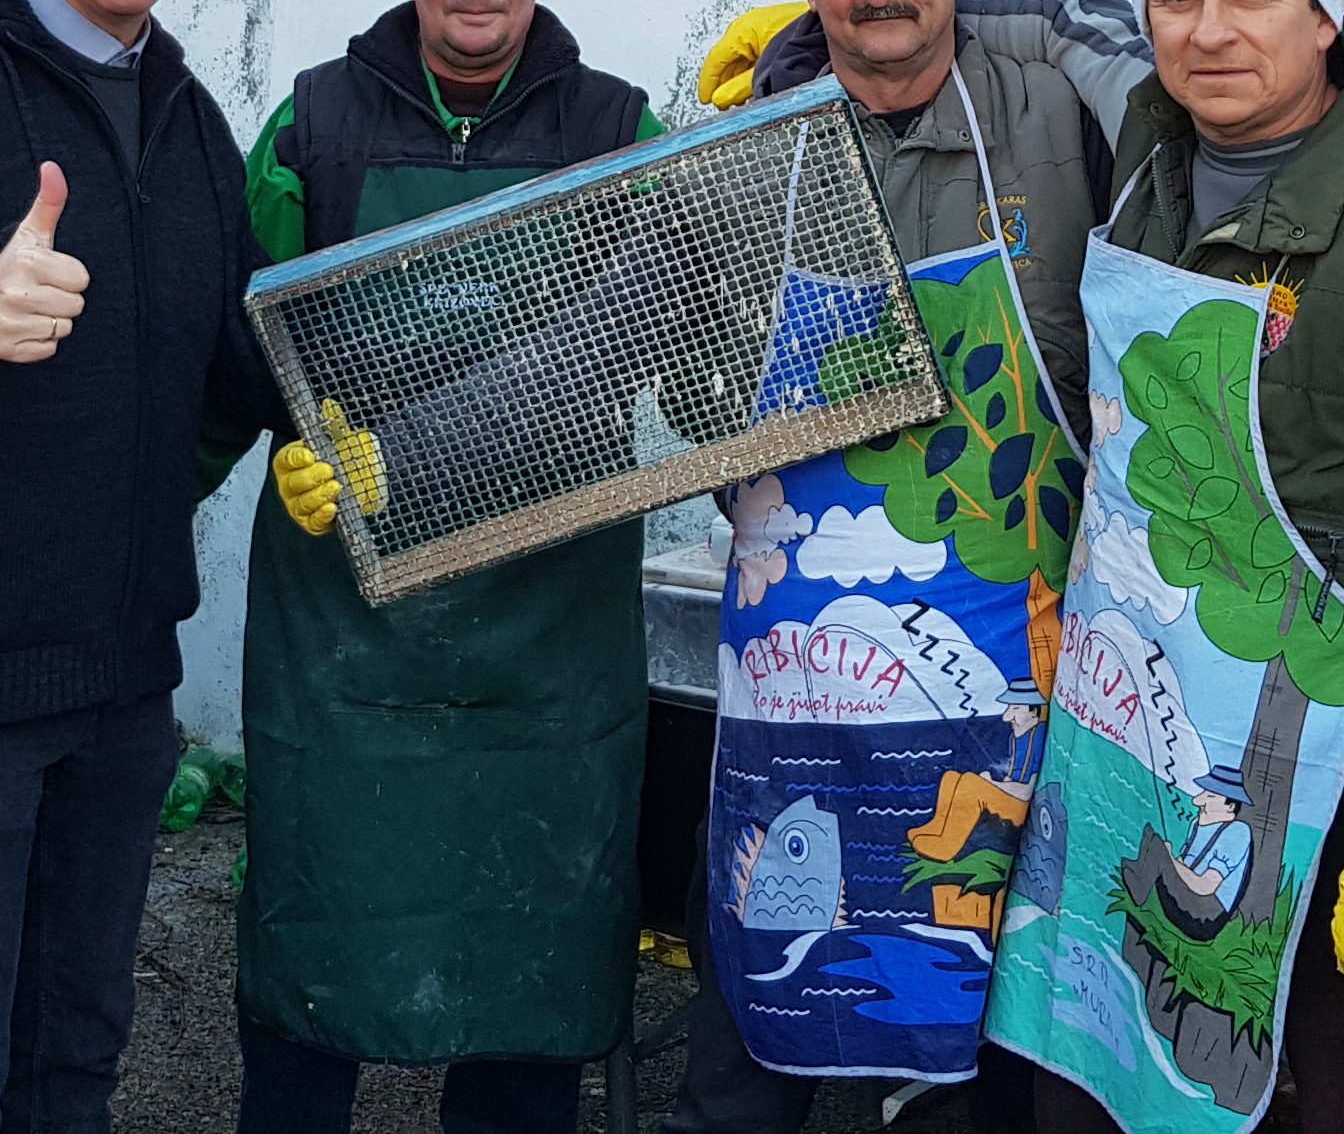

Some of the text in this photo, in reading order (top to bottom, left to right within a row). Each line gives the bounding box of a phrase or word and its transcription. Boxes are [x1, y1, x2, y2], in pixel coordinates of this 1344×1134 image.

[770, 689, 785, 718] je
[787, 691, 832, 720] život
[835, 694, 888, 721] pravi
